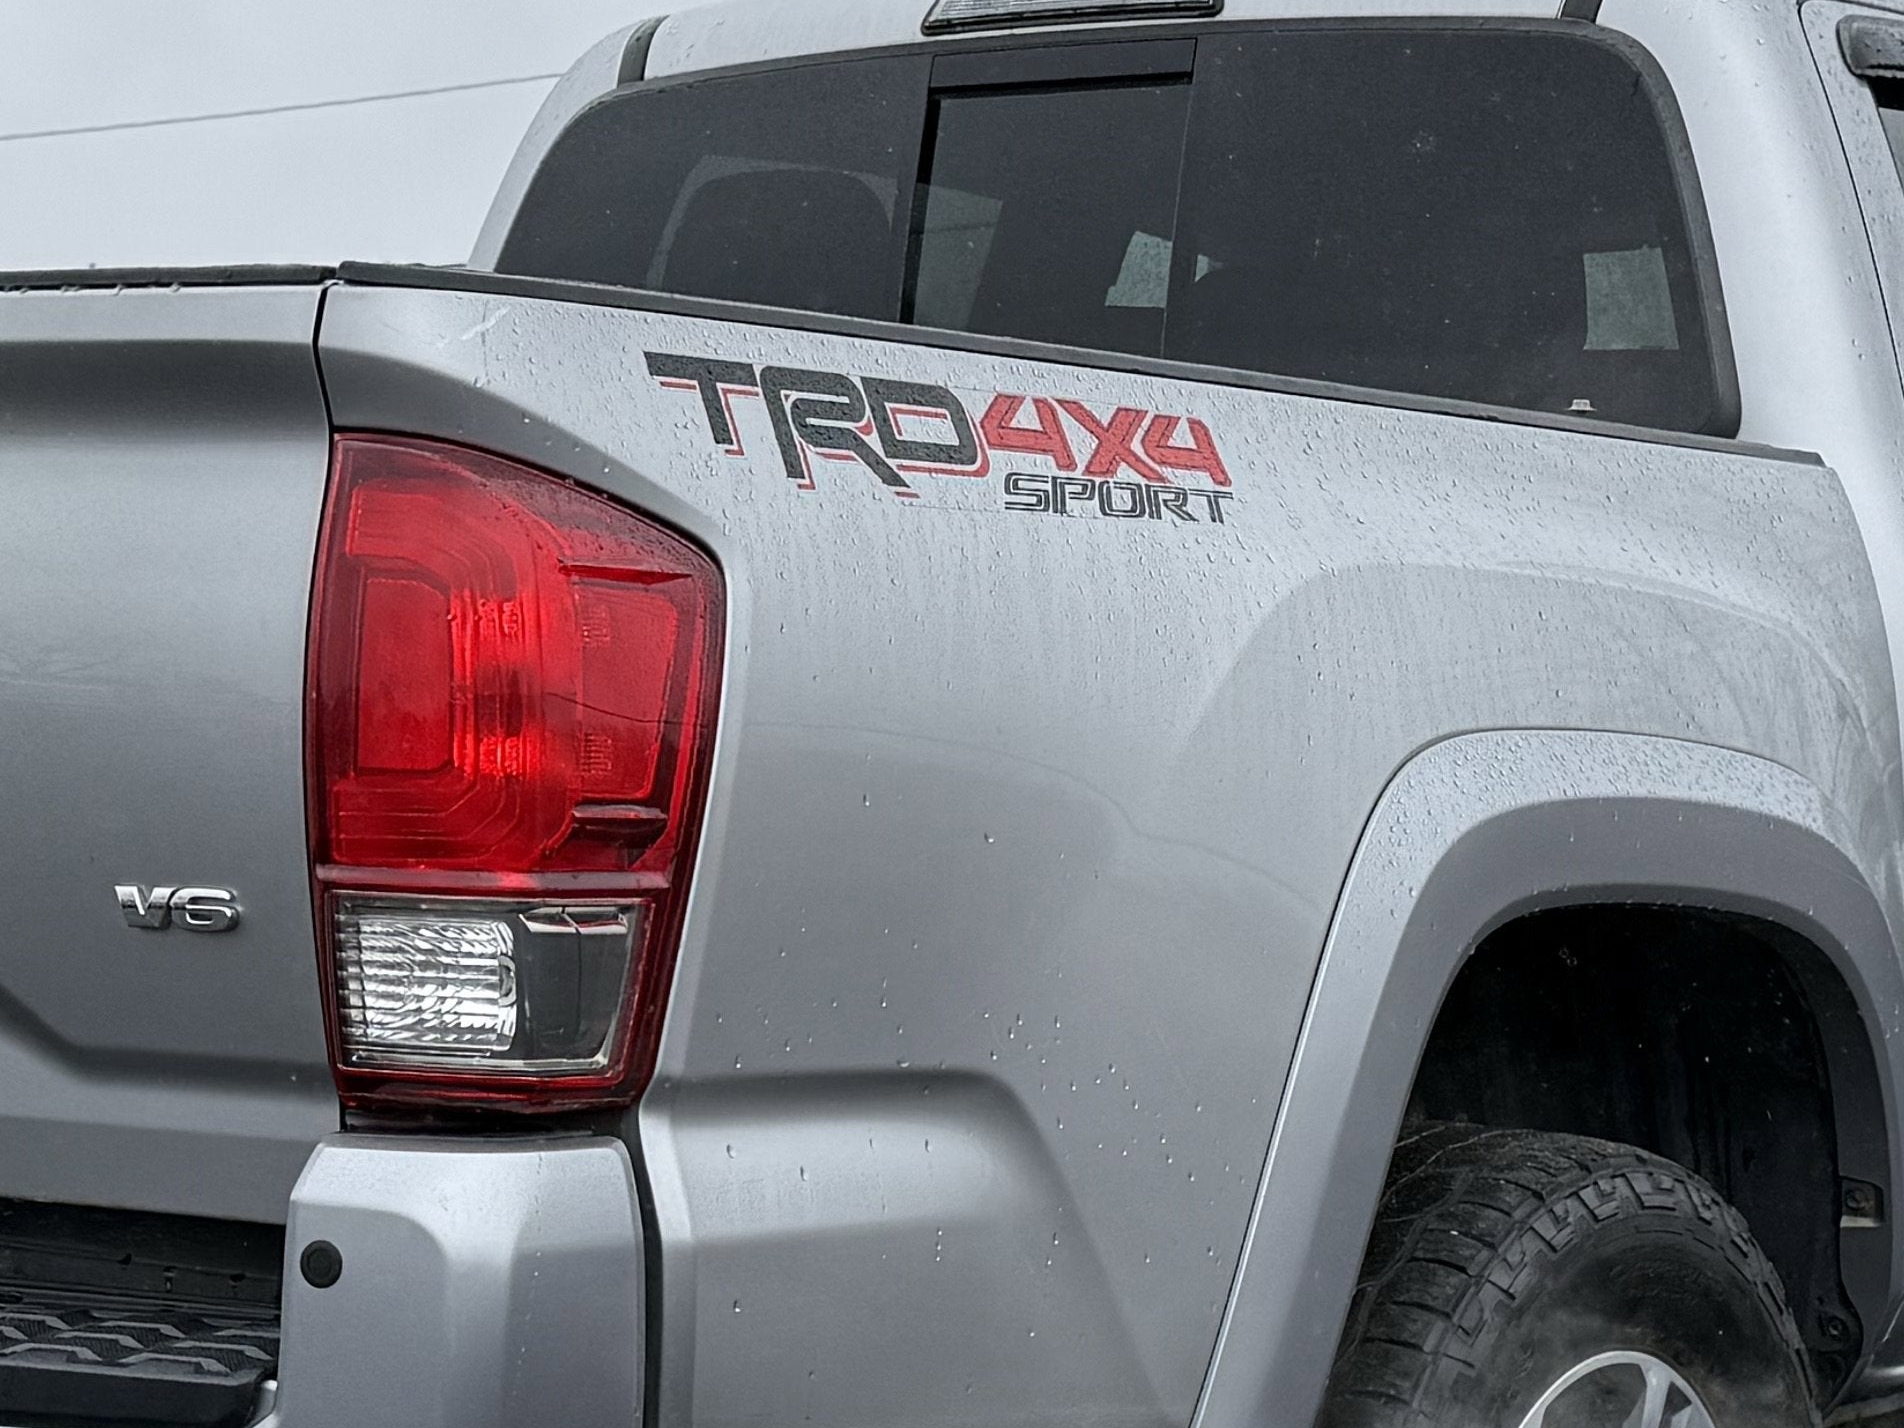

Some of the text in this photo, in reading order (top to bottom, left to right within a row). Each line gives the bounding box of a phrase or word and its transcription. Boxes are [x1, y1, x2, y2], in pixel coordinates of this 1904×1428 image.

[644, 351, 990, 499] TRD
[1004, 472, 1234, 523] SPORT
[114, 884, 240, 932] V6
